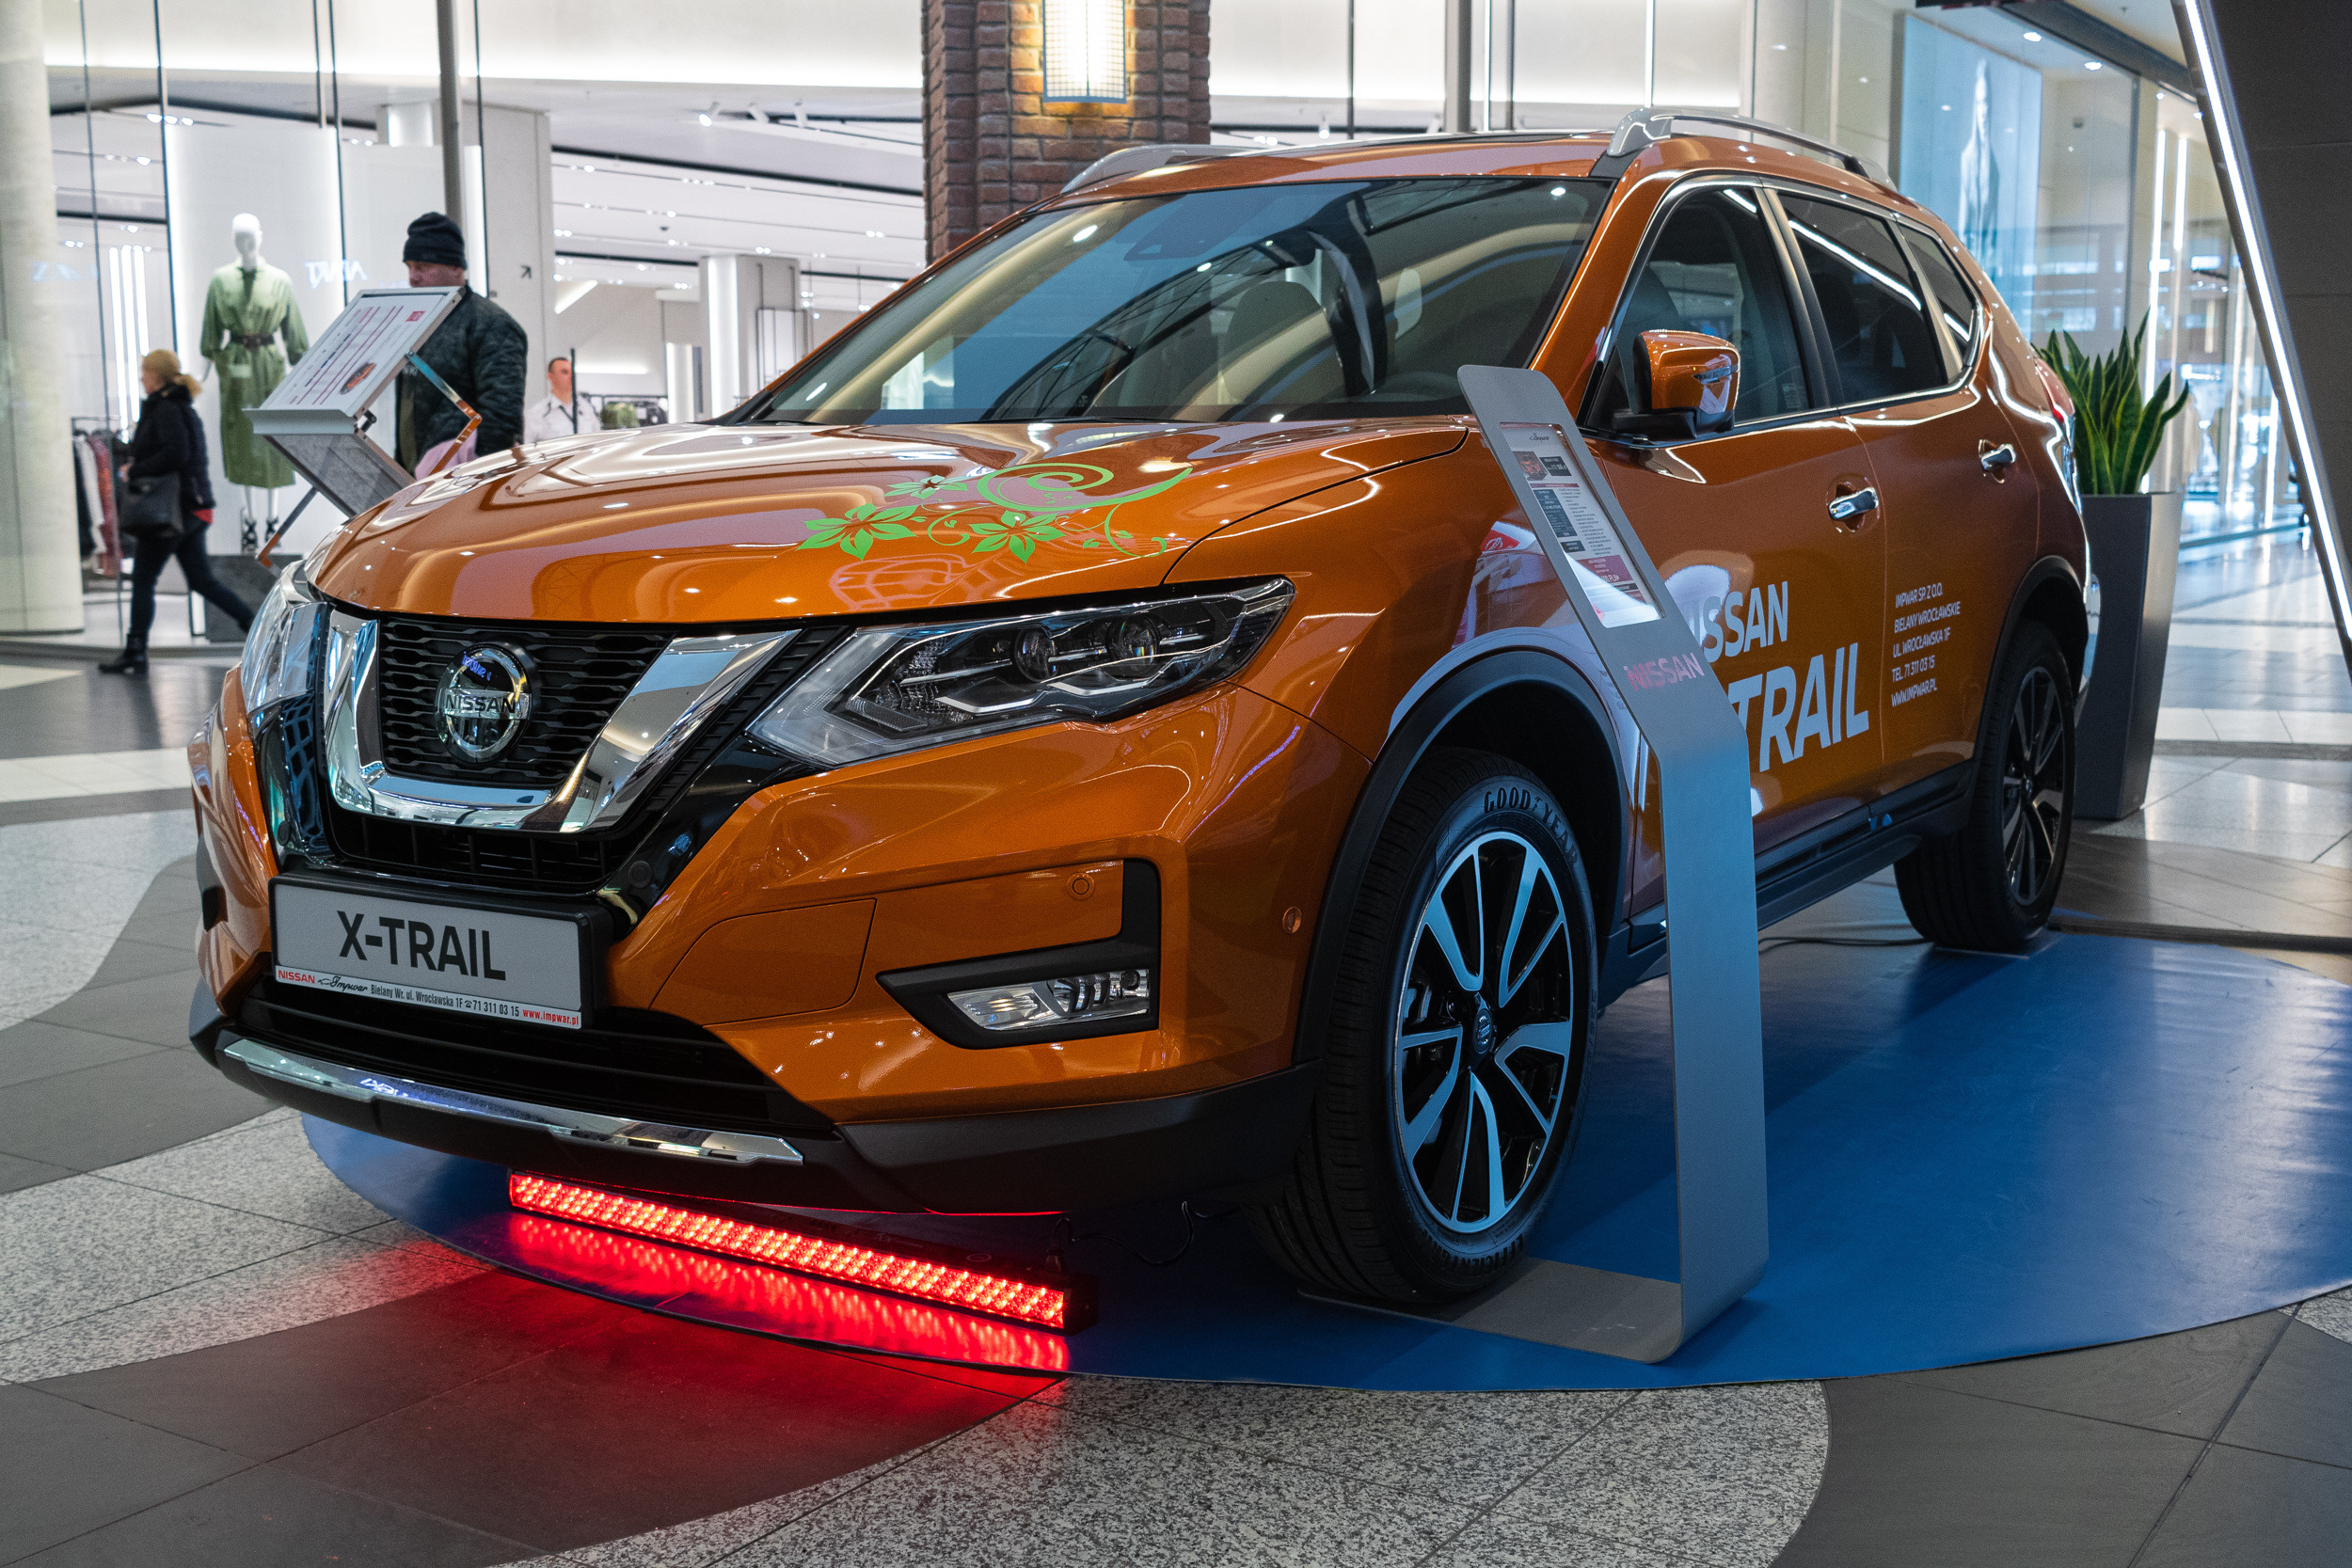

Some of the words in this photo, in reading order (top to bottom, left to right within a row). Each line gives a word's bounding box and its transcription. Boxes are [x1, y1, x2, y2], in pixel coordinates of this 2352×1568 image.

[1693, 580, 1788, 663] ISSAN
[1894, 612, 1919, 634] BIELANY
[445, 692, 517, 714] NISSAN
[1623, 652, 1706, 692] NISSAN
[1727, 641, 1870, 773] TRAIL
[1484, 786, 1579, 865] GOODYEAR
[336, 910, 506, 981] X-TRAIL
[278, 969, 316, 985] NISSAN
[371, 984, 394, 999] Bielany
[394, 987, 405, 999] Wr.
[415, 990, 454, 1007] Wrocławska
[455, 997, 464, 1009] 1F
[472, 999, 482, 1012] 71
[484, 1001, 498, 1015] 311
[499, 1004, 509, 1017] 03
[510, 1005, 520, 1019] 15
[522, 1008, 580, 1026] www.impwar.pl
